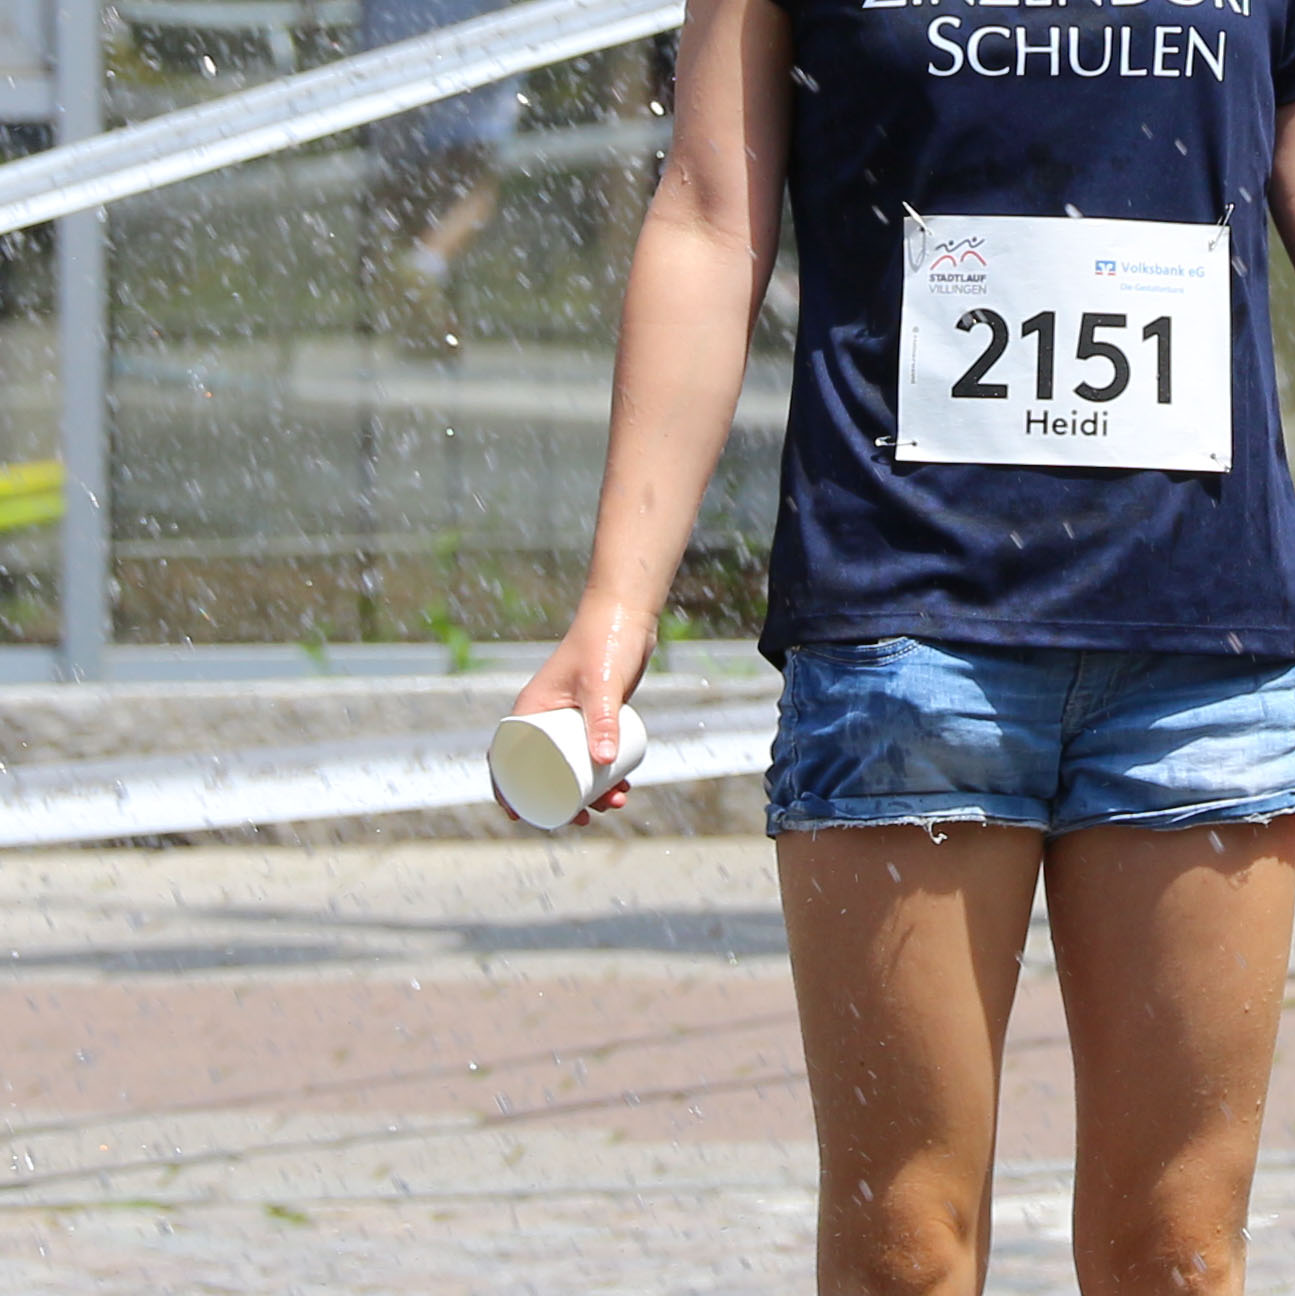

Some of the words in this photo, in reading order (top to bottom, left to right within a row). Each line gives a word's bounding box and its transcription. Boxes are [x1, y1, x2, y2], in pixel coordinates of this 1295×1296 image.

[927, 16, 1226, 82] SCHULEN
[929, 273, 987, 283] STADTLAUF
[1121, 262, 1184, 276] Volksbank
[1188, 266, 1205, 278] eG
[929, 284, 987, 295] VILLINGEN
[951, 308, 1172, 404] 2151
[1025, 410, 1108, 436] Heidi
